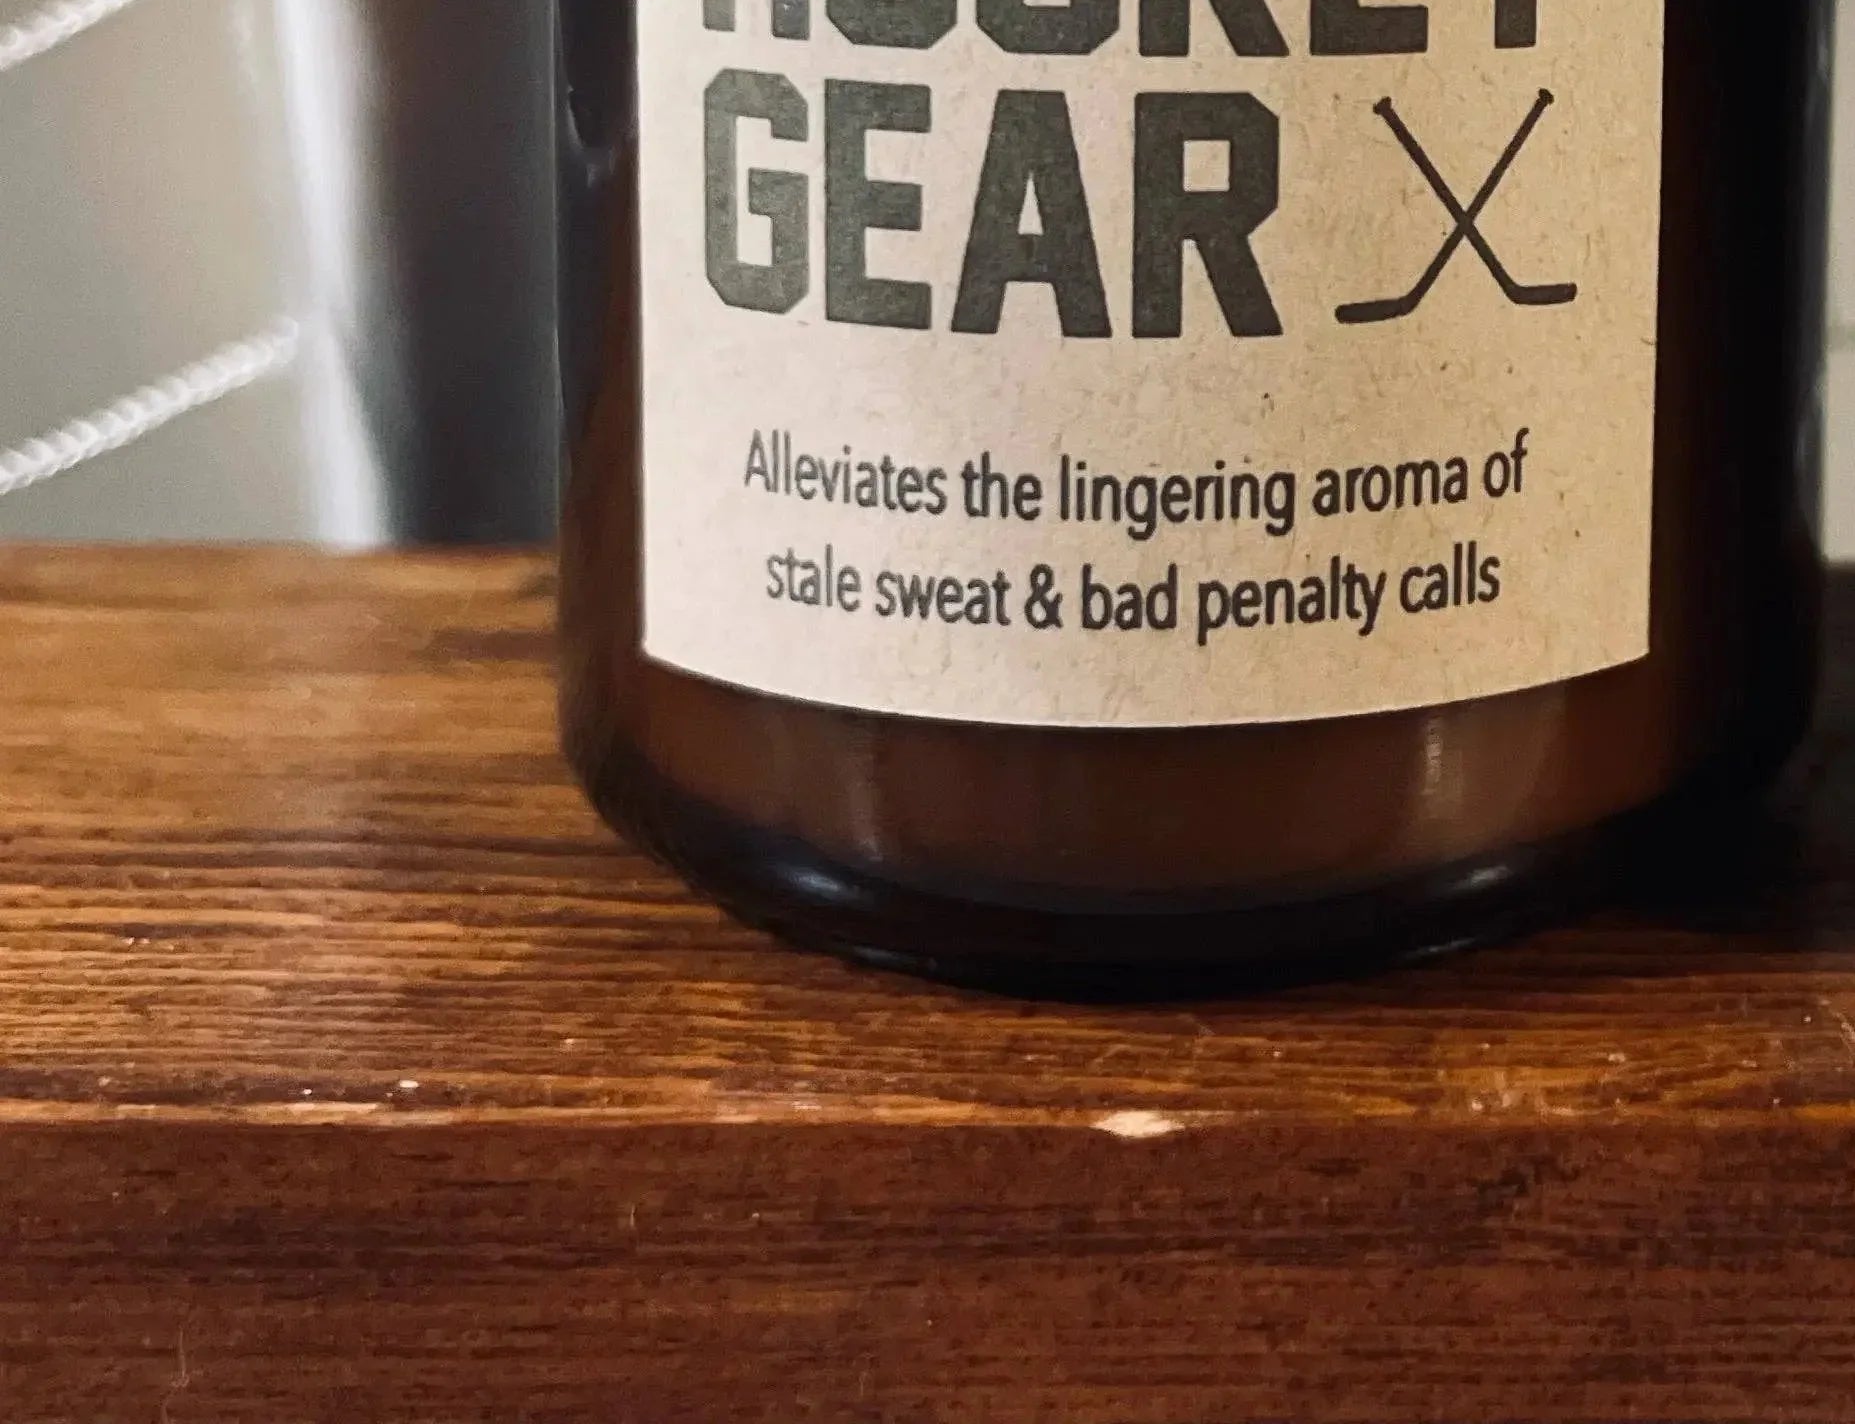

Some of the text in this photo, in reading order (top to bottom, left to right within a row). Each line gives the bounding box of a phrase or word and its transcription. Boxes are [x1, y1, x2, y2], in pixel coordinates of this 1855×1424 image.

[704, 69, 1283, 339] GEAR
[745, 427, 1529, 541] Alleviates the lingering aroma of
[767, 540, 1500, 647] stale sweat & bad penalty calls
